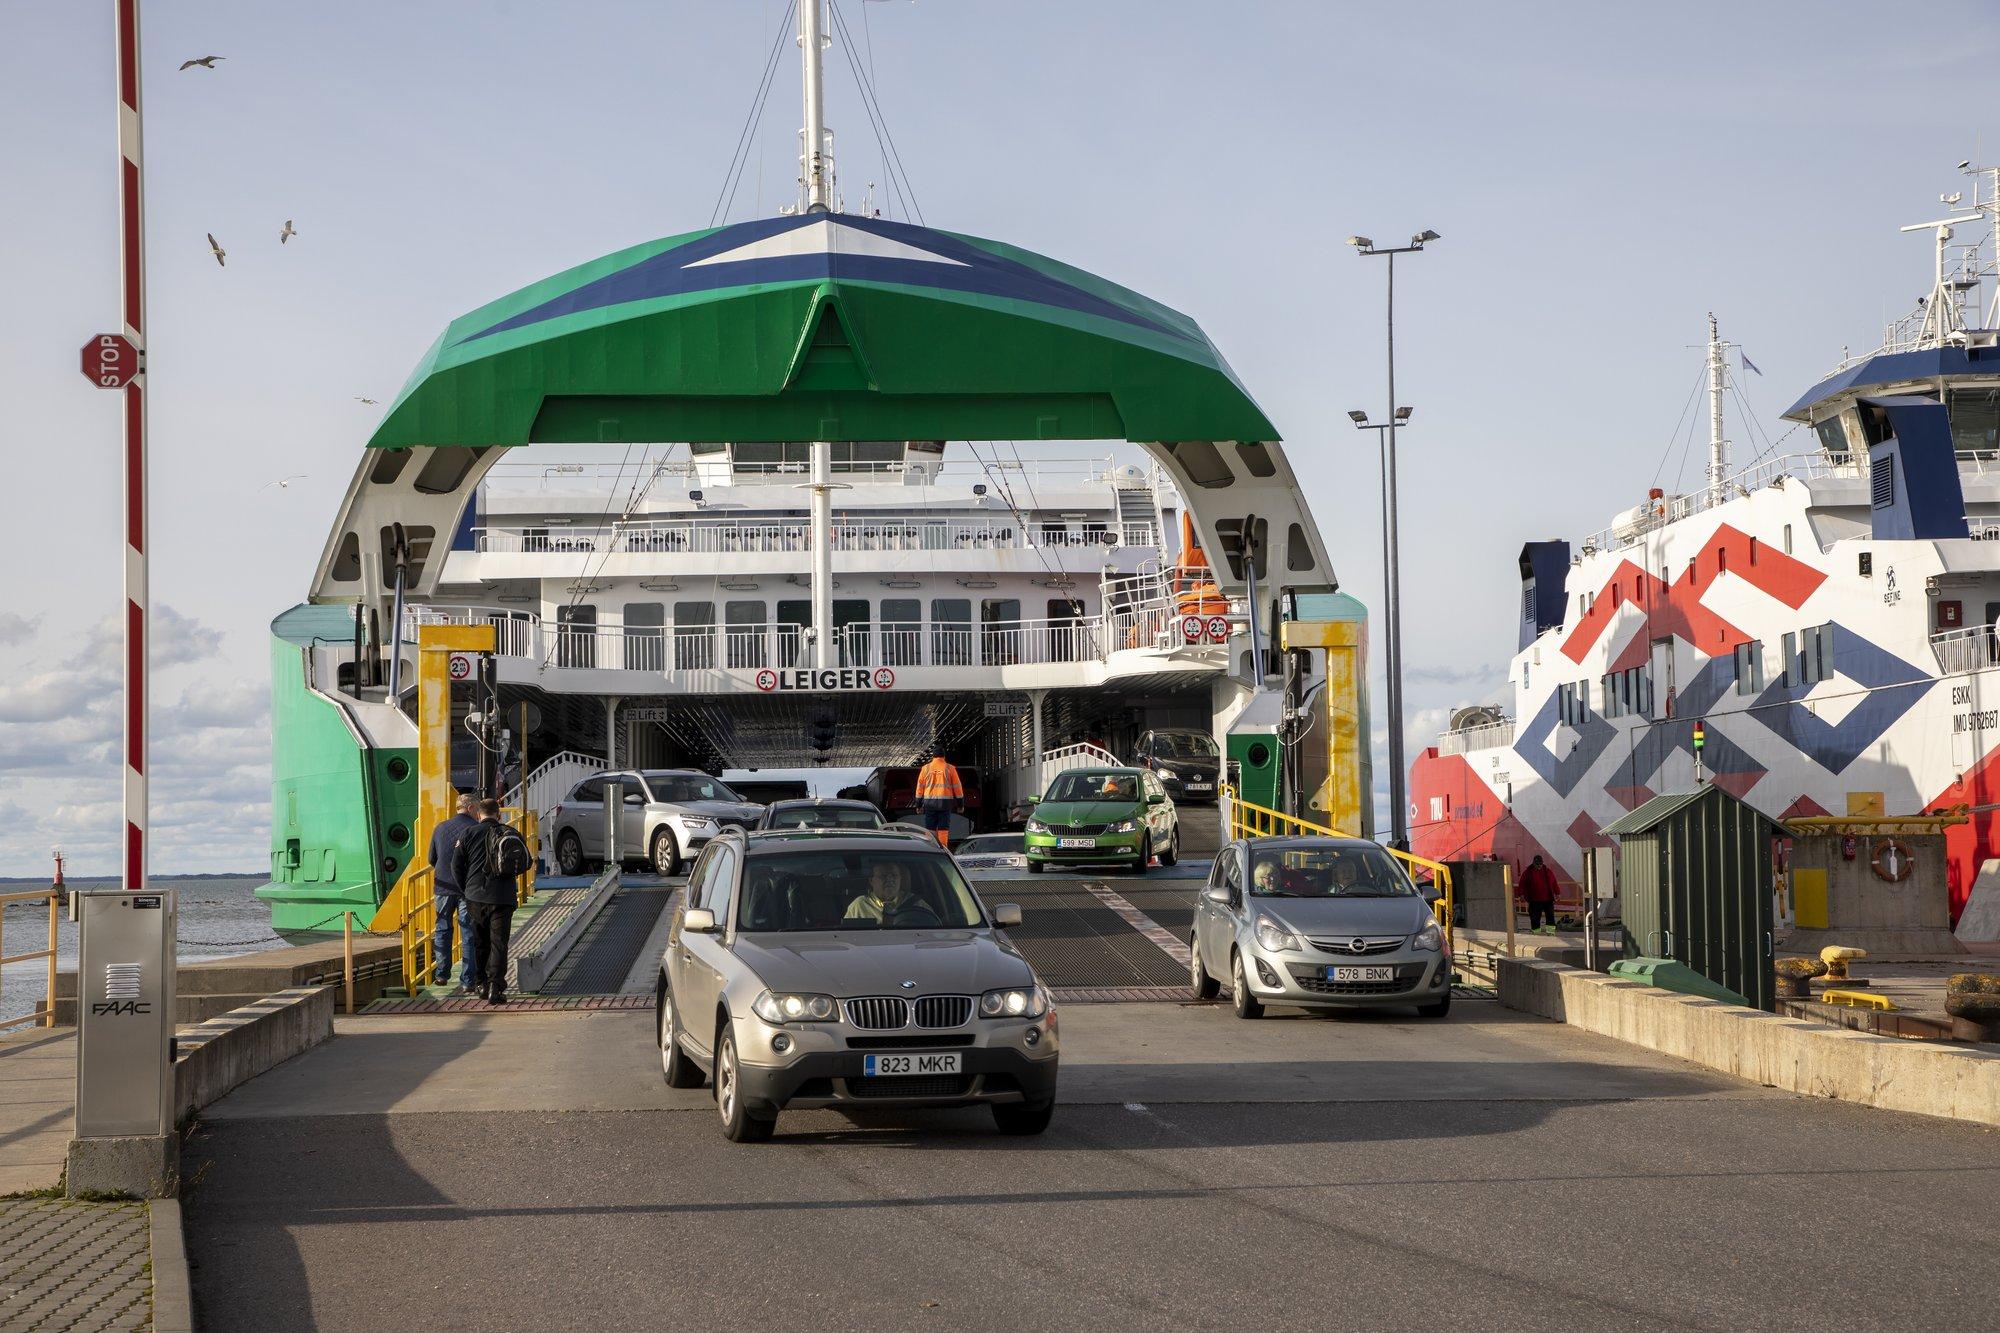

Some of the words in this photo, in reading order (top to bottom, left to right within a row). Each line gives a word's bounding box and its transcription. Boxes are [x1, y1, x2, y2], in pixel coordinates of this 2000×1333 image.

[101, 336, 119, 386] STOP
[780, 670, 871, 690] LEIGER
[1952, 686, 1971, 705] ESKK
[639, 710, 657, 720] Lift
[1000, 705, 1017, 714] Lift
[1953, 714, 1967, 732] IMO
[1968, 710, 1998, 731] 9762687
[1338, 968, 1359, 979] 578
[1365, 968, 1390, 979] BNK
[92, 1001, 151, 1016] FAAC
[881, 1057, 910, 1073] 823
[918, 1055, 955, 1072] MKR
